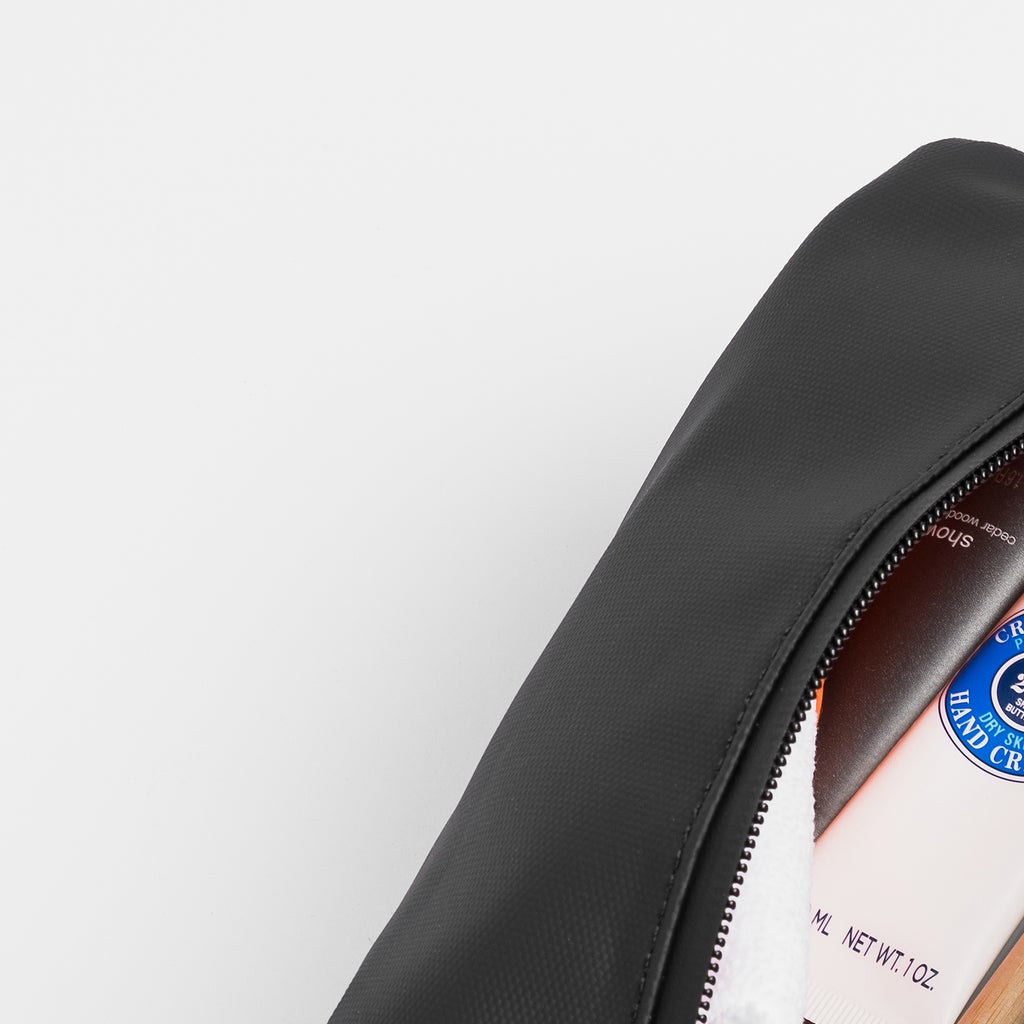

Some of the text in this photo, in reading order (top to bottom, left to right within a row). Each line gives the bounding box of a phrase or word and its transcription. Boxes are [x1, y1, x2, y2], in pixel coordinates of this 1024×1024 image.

[945, 510, 1017, 545] cedar wood
[950, 690, 989, 750] HAND
[978, 711, 1005, 738] DRY
[811, 908, 940, 992] ML NET WT. 1 OZ.
